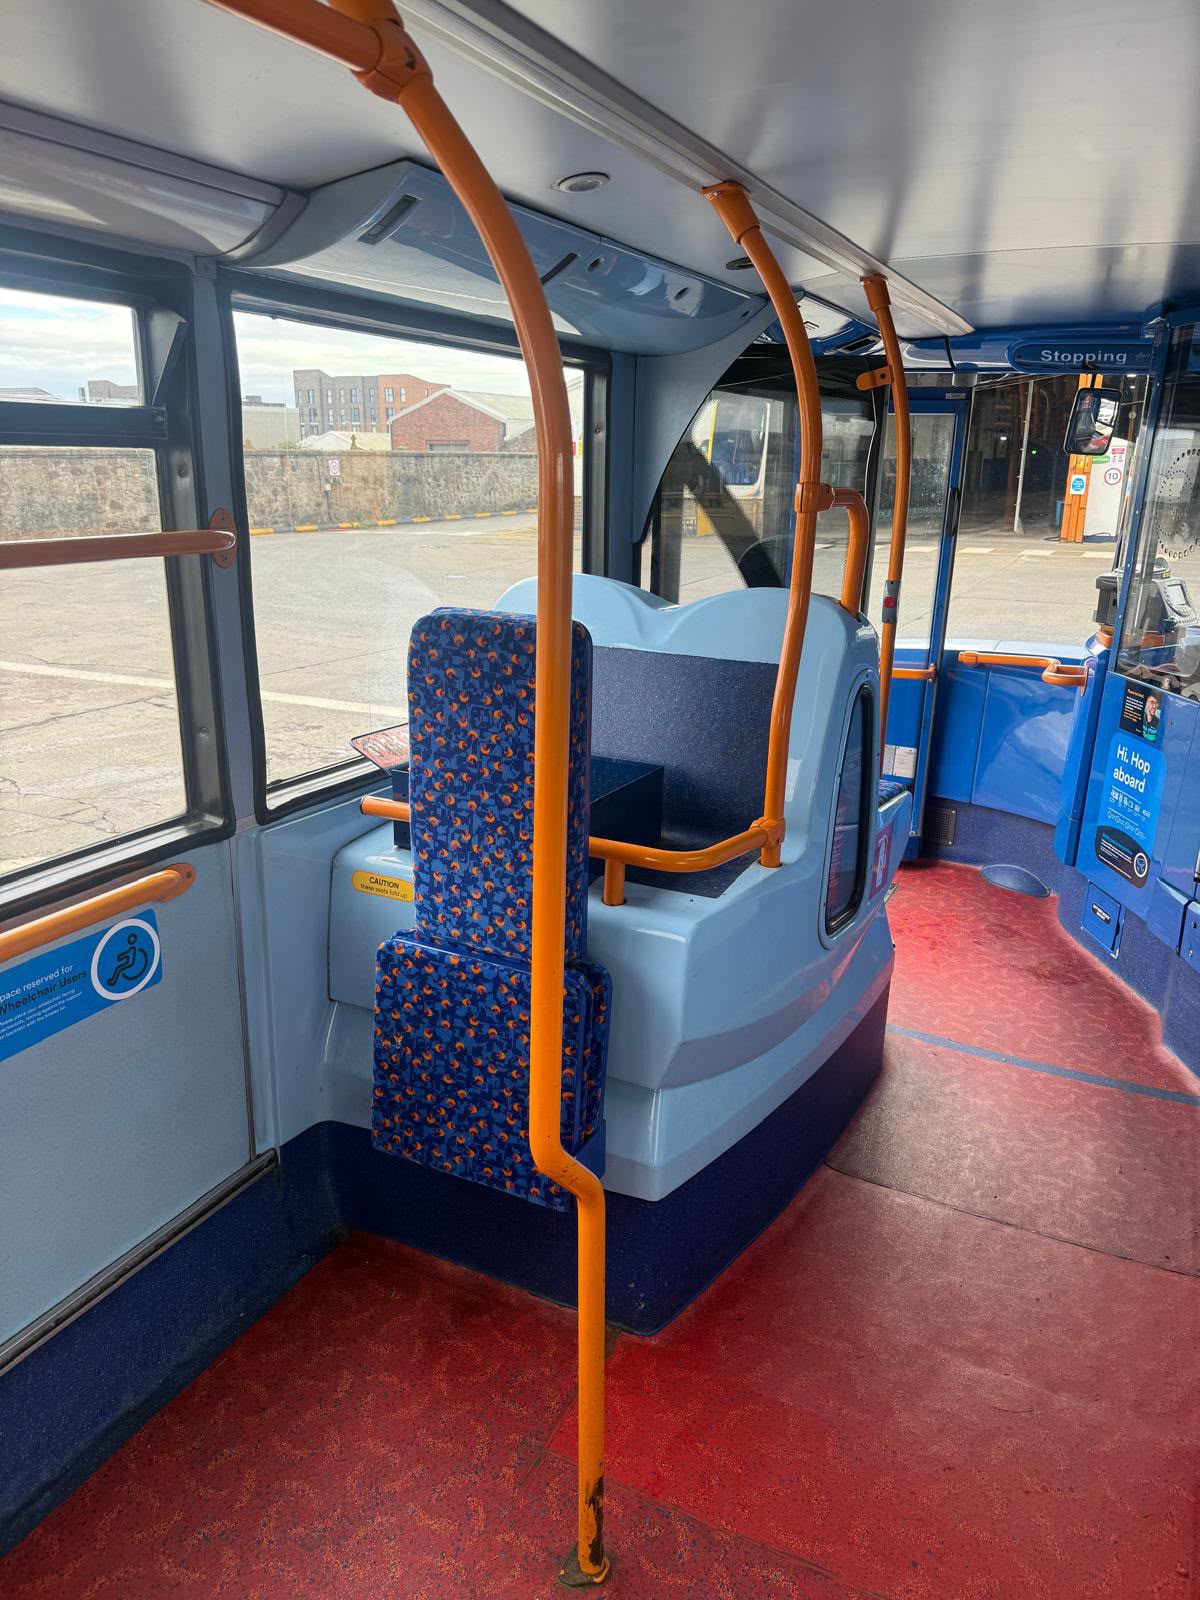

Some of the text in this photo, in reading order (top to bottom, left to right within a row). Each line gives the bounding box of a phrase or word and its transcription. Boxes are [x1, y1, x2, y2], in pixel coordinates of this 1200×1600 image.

[1040, 349, 1127, 365] Stopping
[1108, 472, 1119, 480] 10
[1116, 744, 1151, 776] Hi. Hop
[1113, 765, 1146, 793] aboard
[360, 883, 375, 892] these
[375, 887, 389, 895] seats
[389, 889, 400, 897] fold
[369, 876, 400, 889] CAUTION
[0, 964, 74, 1004] pace reserved for
[60, 970, 88, 988] Users
